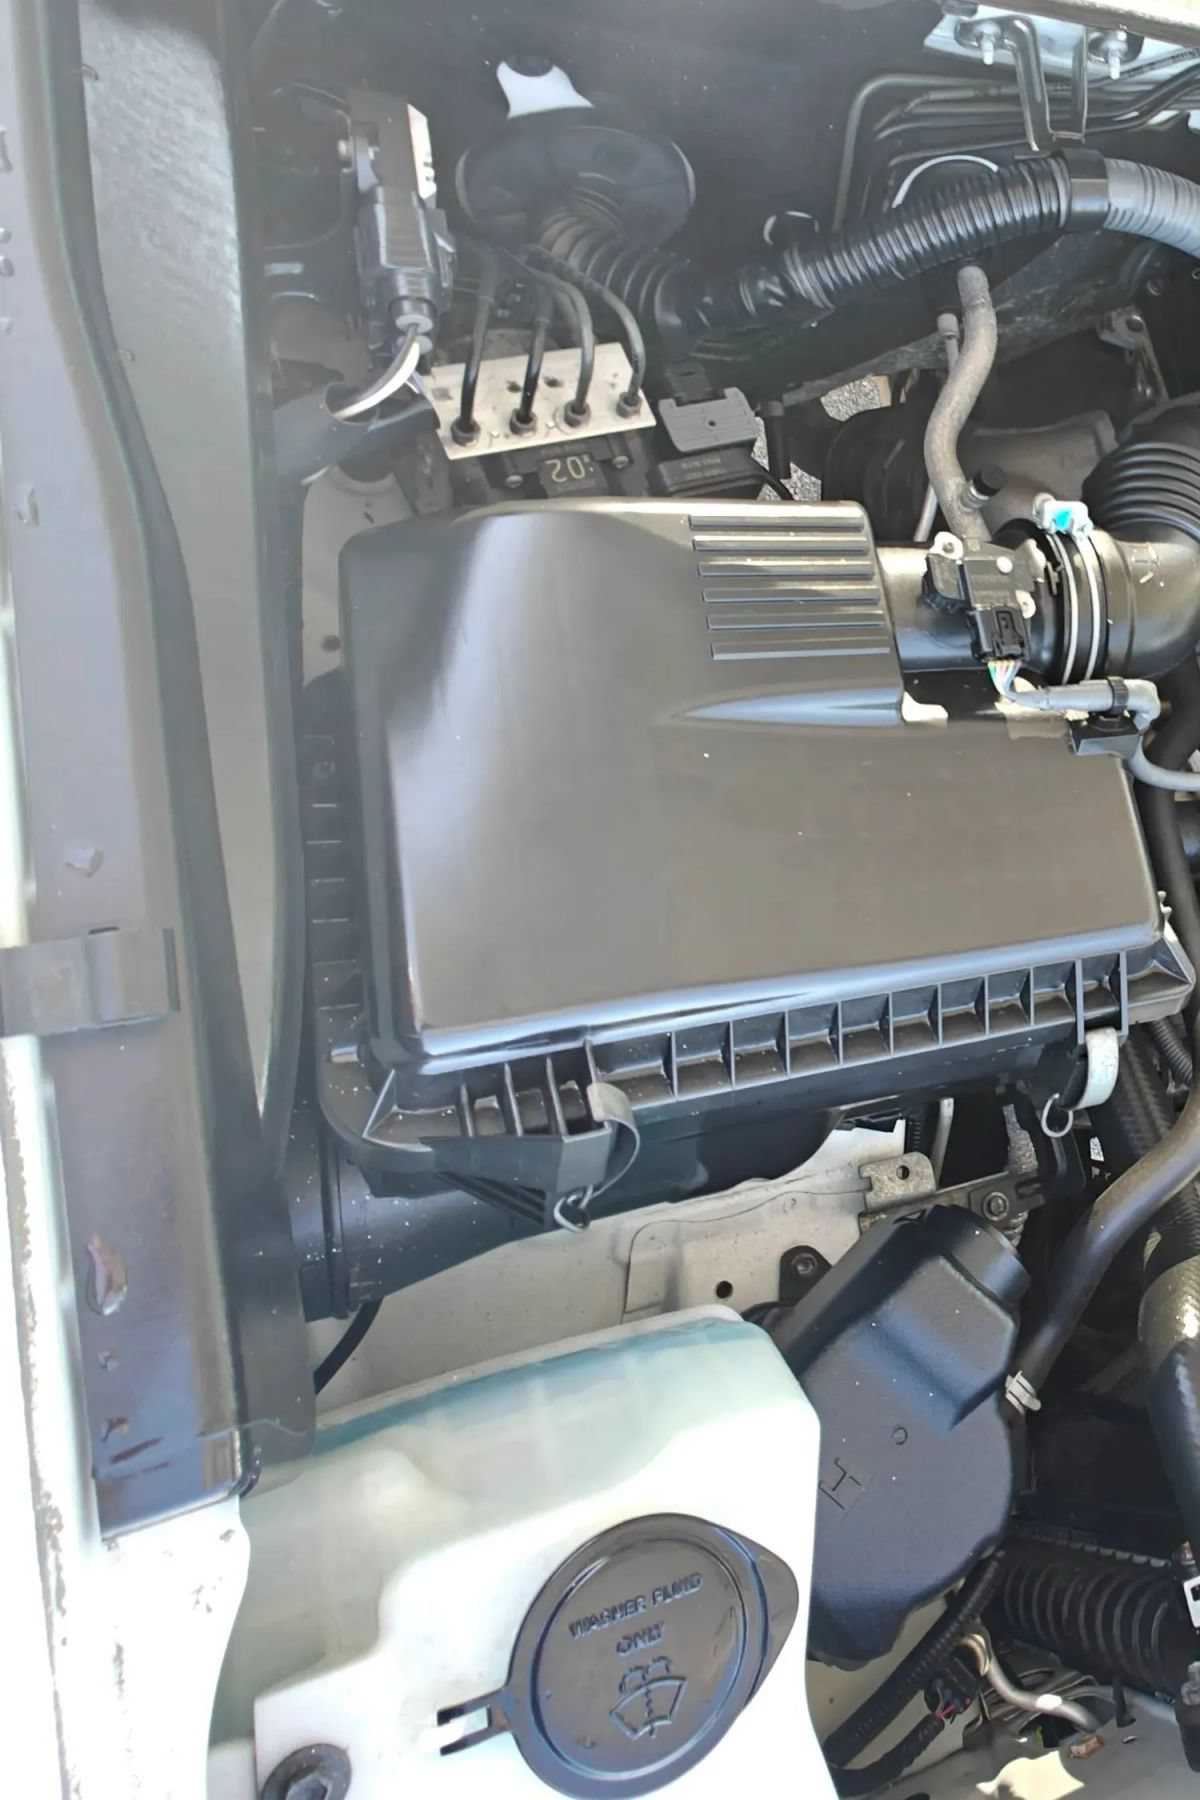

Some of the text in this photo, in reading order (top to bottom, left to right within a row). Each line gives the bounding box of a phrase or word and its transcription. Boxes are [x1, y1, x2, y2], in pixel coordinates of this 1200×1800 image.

[568, 1572, 702, 1640] WASHER FLUID
[616, 1620, 665, 1656] ONLY
